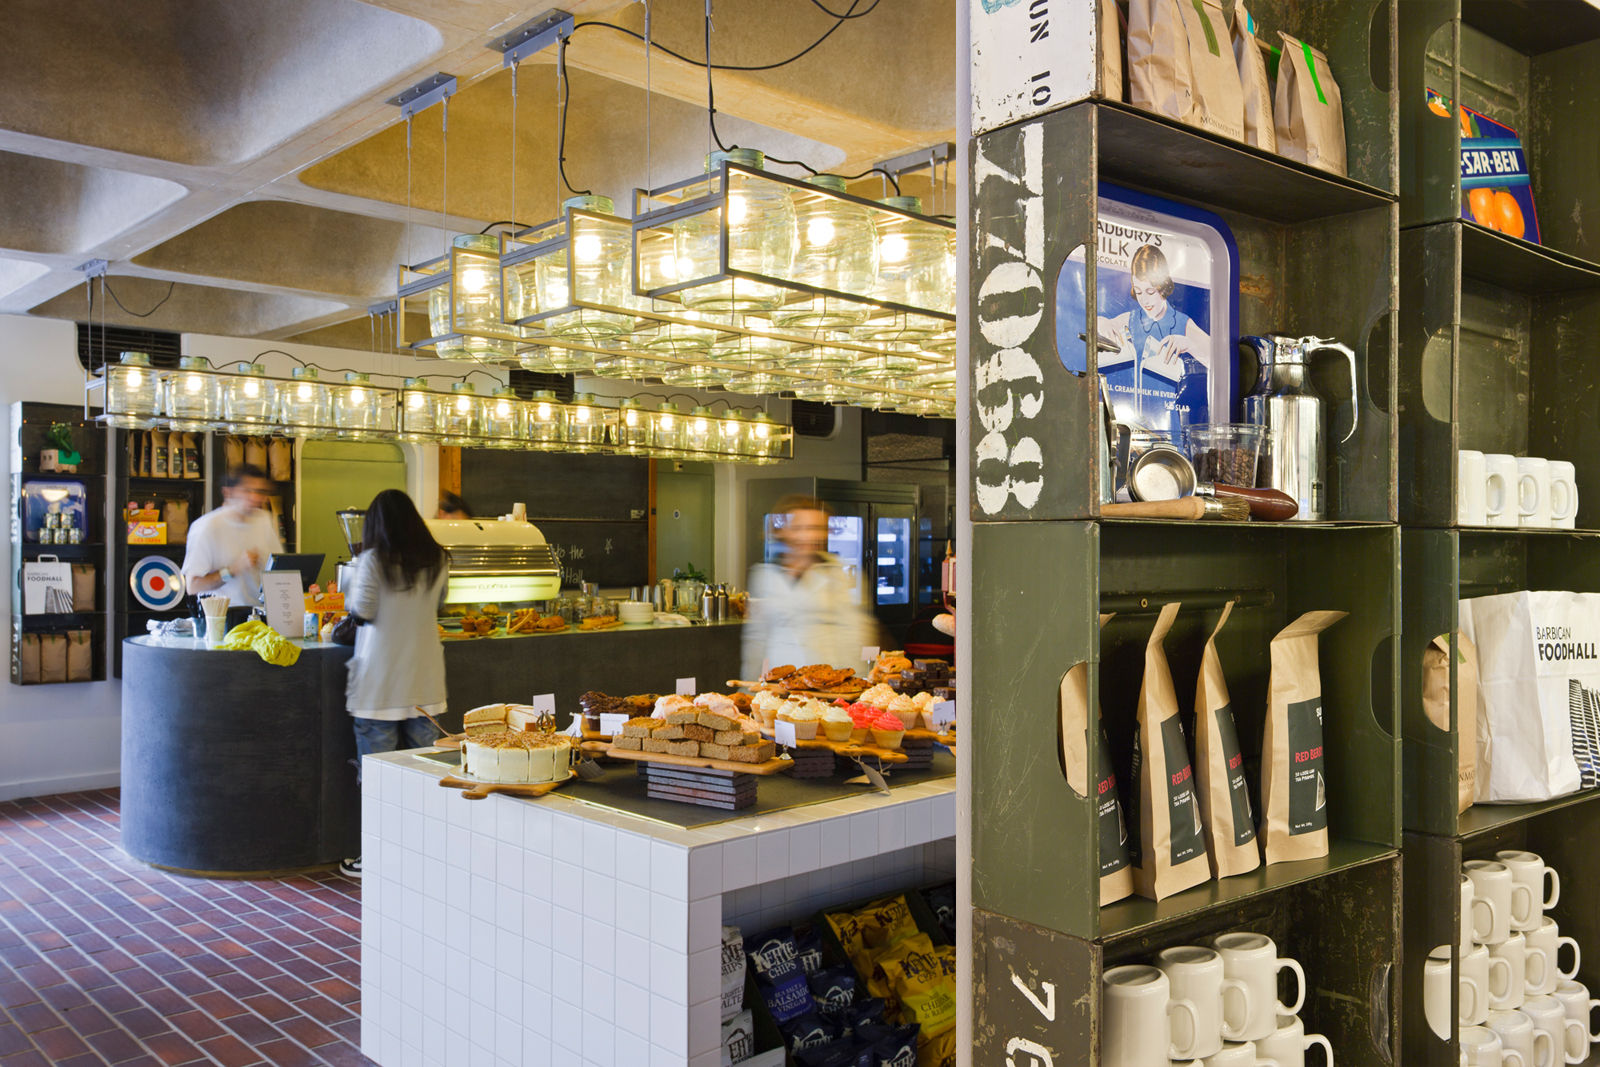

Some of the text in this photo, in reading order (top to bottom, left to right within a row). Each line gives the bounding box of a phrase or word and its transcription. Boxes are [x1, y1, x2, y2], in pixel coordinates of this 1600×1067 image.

[1097, 220, 1163, 247] ADBURY'S
[1097, 236, 1129, 258] ILK
[1536, 626, 1572, 640] BARBICAN
[1538, 642, 1598, 661] FOODHALL
[1295, 751, 1310, 764] RED
[750, 938, 799, 974] KETTLE
[721, 961, 744, 977] HIPS
[768, 959, 797, 979] CHIPS
